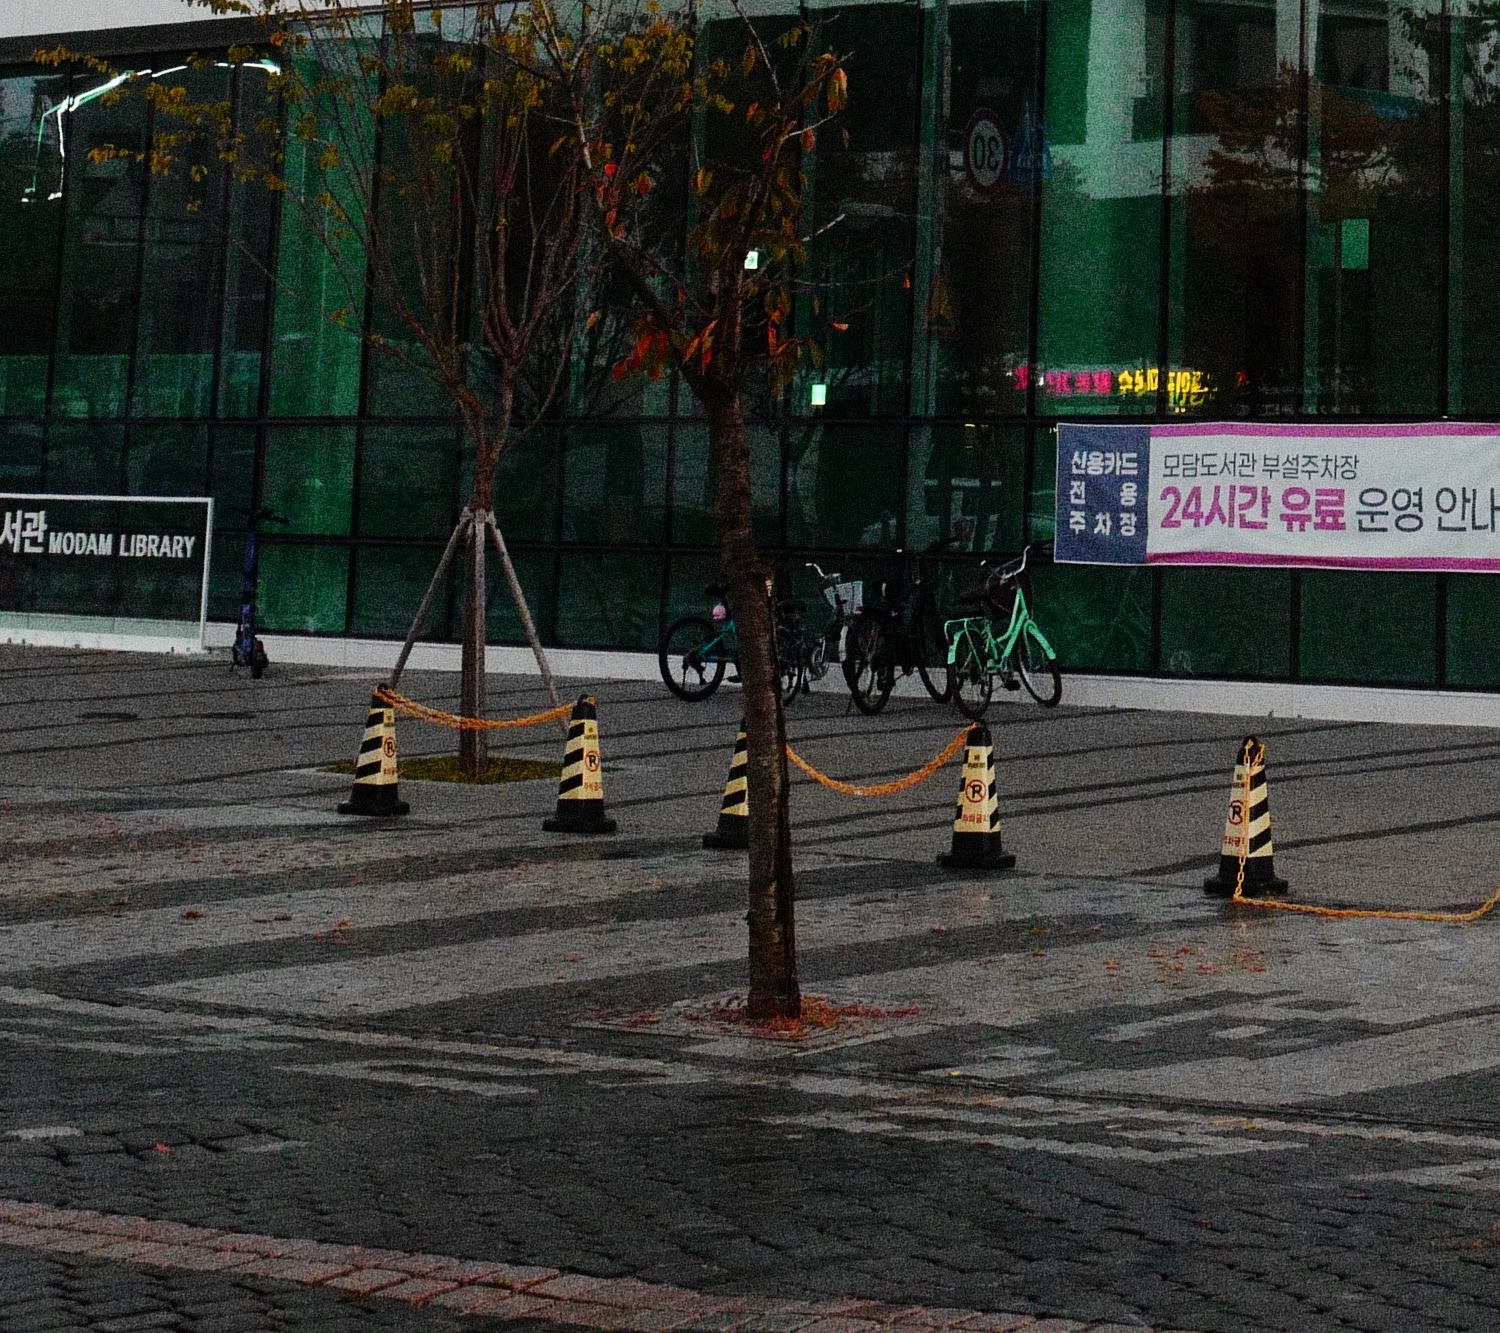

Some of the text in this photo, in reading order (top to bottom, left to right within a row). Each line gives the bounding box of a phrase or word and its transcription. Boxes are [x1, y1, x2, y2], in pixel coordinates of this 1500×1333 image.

[1071, 451, 1138, 476] 신용카드
[1163, 453, 1359, 480] 모담도서관 부설주차장
[1159, 484, 1271, 530] 24시간
[1279, 486, 1346, 532] 유료
[1355, 486, 1423, 533] 운영
[48, 531, 113, 557] MODAM
[119, 534, 196, 560] LIBRARY
